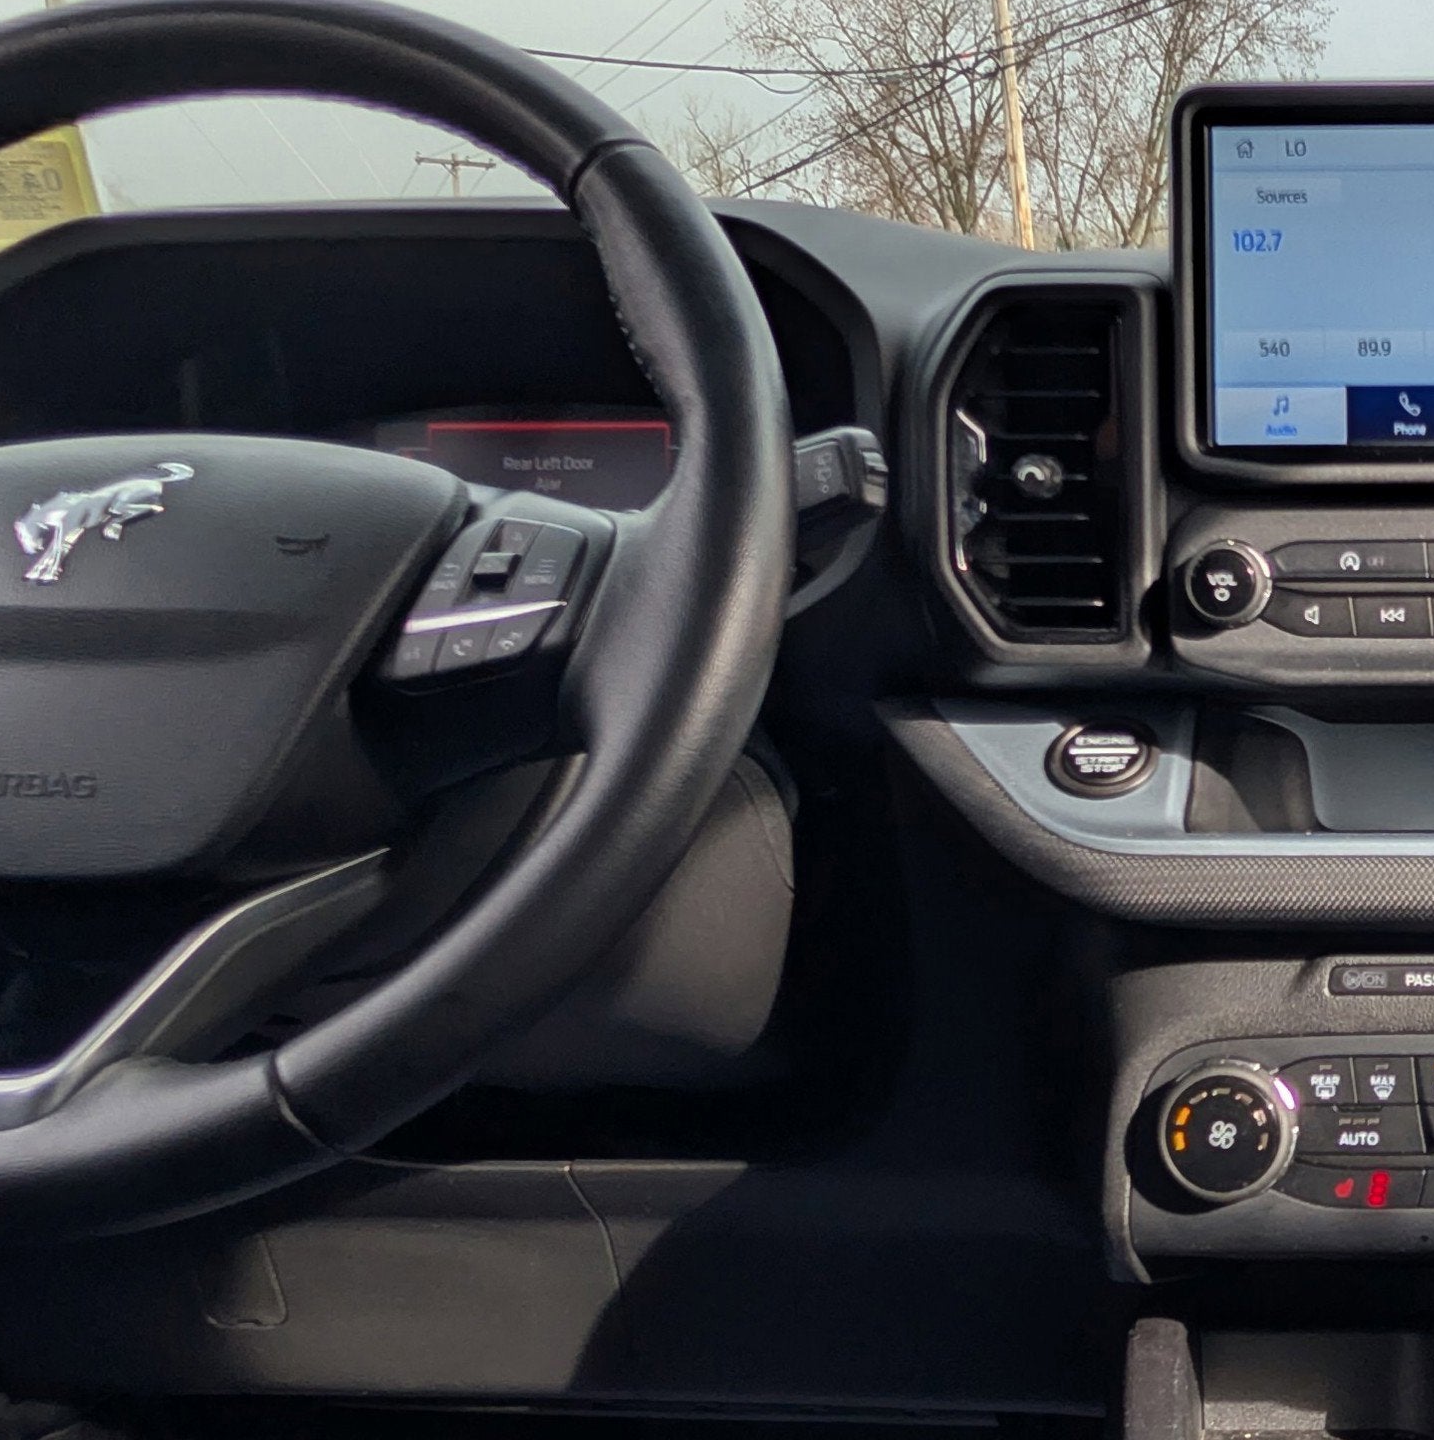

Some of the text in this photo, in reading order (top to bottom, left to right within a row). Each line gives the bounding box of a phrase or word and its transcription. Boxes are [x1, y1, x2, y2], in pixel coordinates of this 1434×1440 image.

[1284, 140, 1307, 158] LO
[1256, 188, 1308, 205] Sources
[1232, 229, 1283, 253] 102.7
[1259, 340, 1291, 358] 540
[1357, 339, 1392, 358] 89.9
[1266, 424, 1298, 438] Audio
[1393, 422, 1427, 437] Phone
[503, 456, 594, 471] Rear Left Door
[1206, 572, 1237, 587] VOL
[1309, 1074, 1342, 1087] REAR
[1369, 1074, 1397, 1086] MAX
[1338, 1131, 1381, 1146] AUTO
